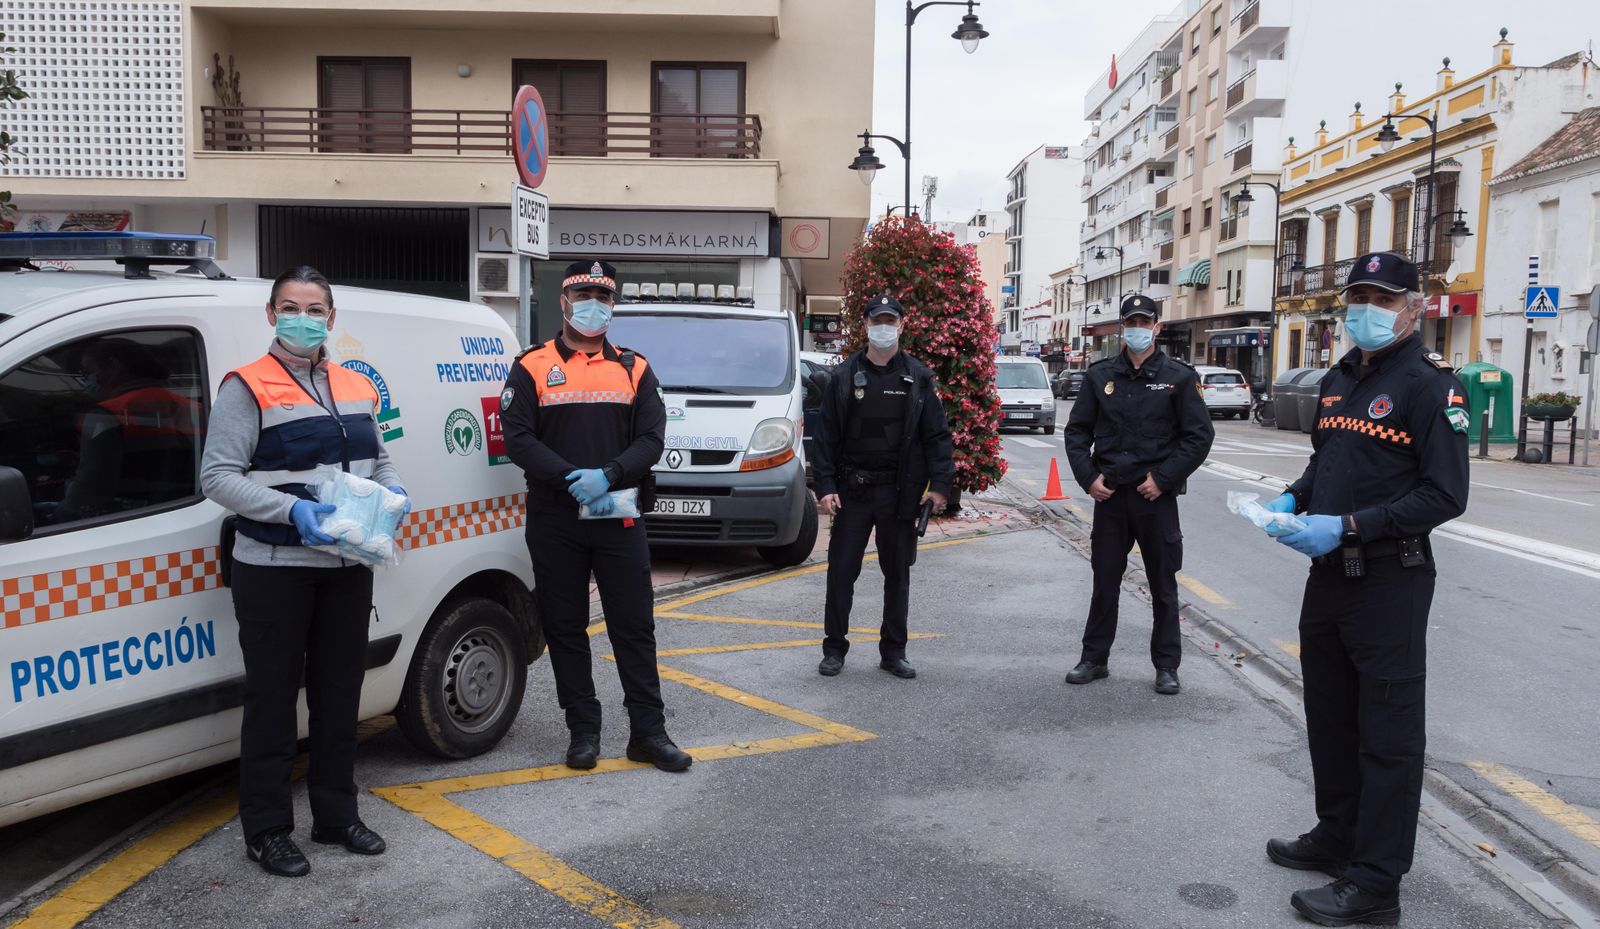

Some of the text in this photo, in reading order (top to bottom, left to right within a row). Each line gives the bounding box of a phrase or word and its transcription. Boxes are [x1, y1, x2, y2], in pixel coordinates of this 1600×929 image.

[519, 197, 546, 223] EXCEPTO
[527, 223, 540, 245] BUS
[560, 231, 758, 249] BOSTADSMÄKLARNA
[461, 337, 505, 355] UNIDAD
[437, 359, 509, 382] PREVENCIÓN
[372, 373, 389, 402] CIVIL
[705, 436, 743, 450] CIVIL
[682, 501, 705, 514] DZX
[11, 616, 216, 703] PROTECCIÓN
